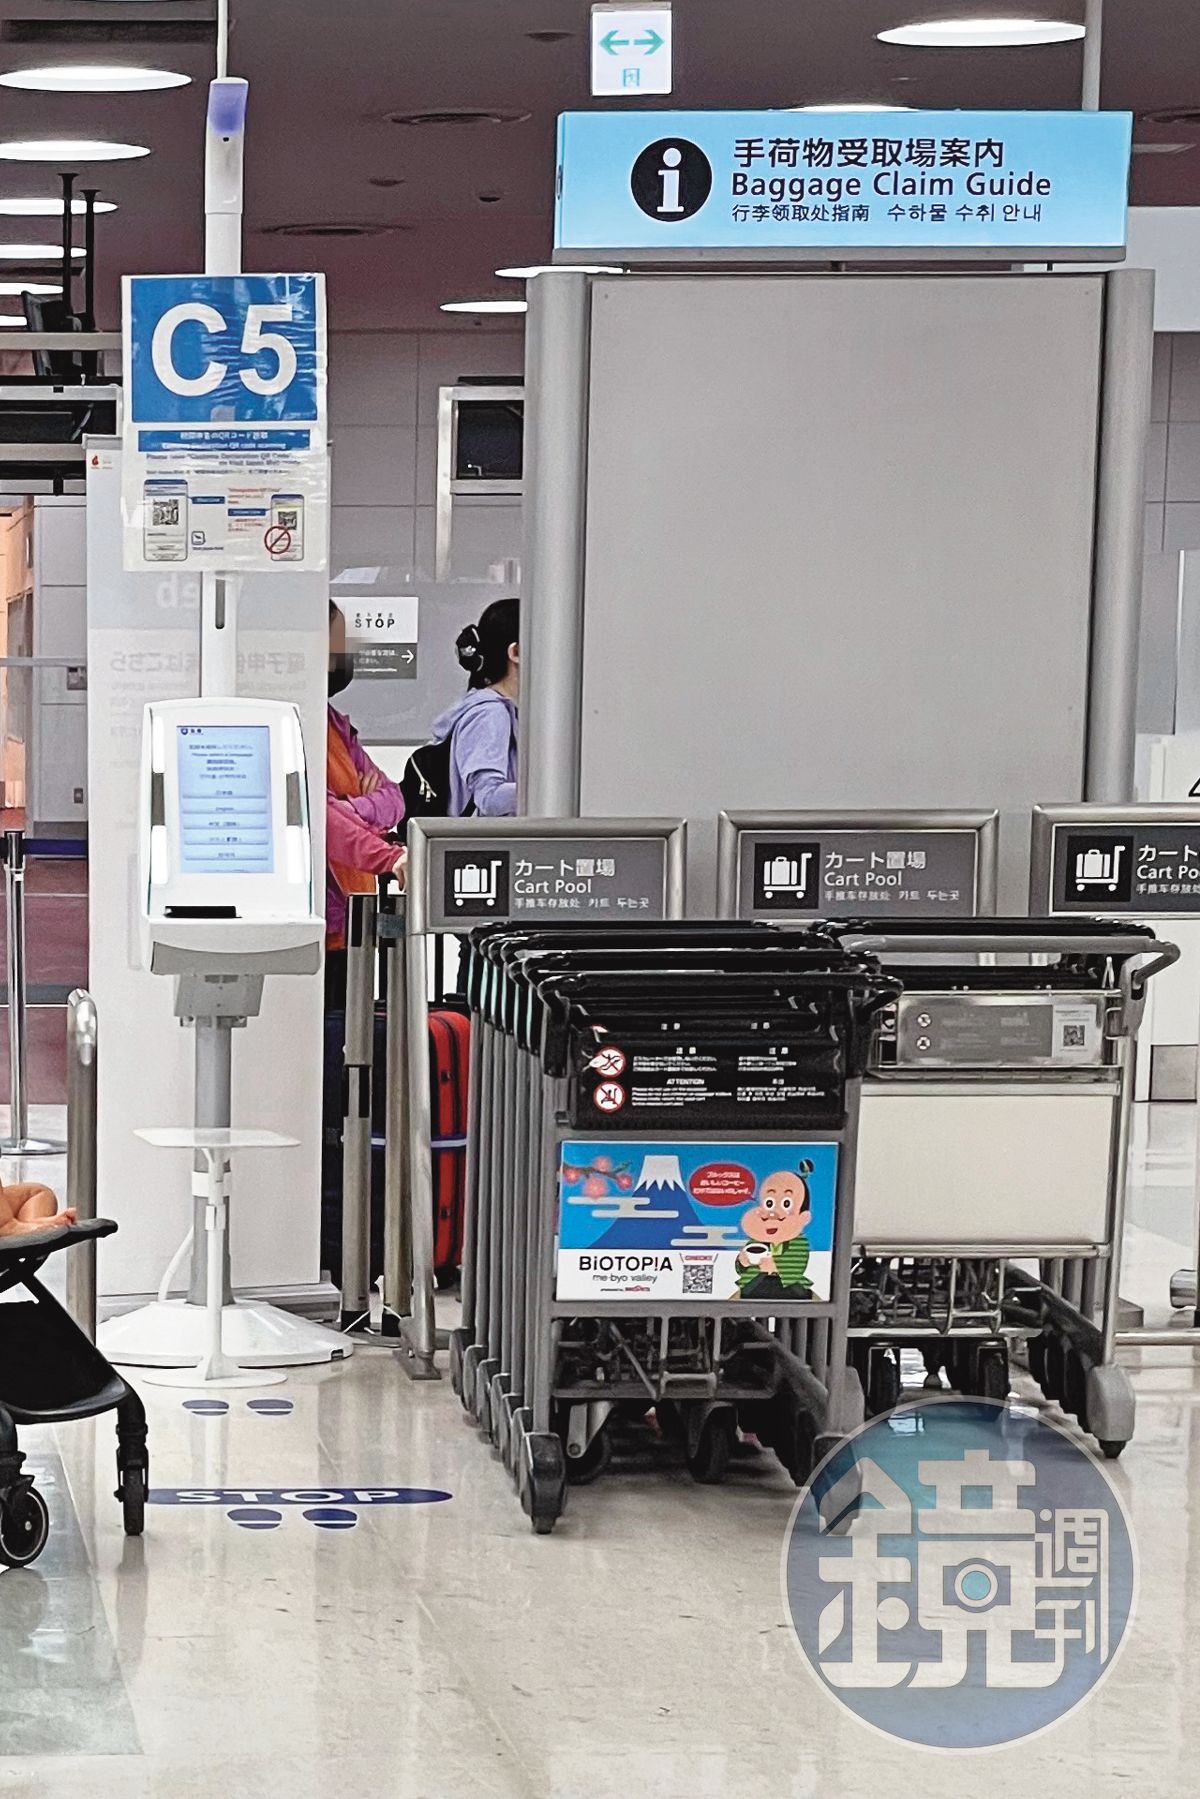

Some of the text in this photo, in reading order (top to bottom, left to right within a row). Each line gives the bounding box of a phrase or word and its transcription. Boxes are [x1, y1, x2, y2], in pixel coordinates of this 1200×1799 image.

[734, 138, 1005, 168] 手荷物受取場案内
[731, 171, 1051, 202] Baggage Claim Guide
[731, 203, 870, 222] 行李领取处指南
[887, 203, 1042, 222] 수하물 수취 안내
[151, 302, 298, 397] C5
[355, 618, 395, 628] STOP
[1138, 844, 1198, 862] カート
[824, 870, 902, 886] Cart Pool
[1136, 864, 1200, 880] Cart Po
[514, 878, 591, 894] Cart Pool
[175, 1490, 400, 1502] STOP
